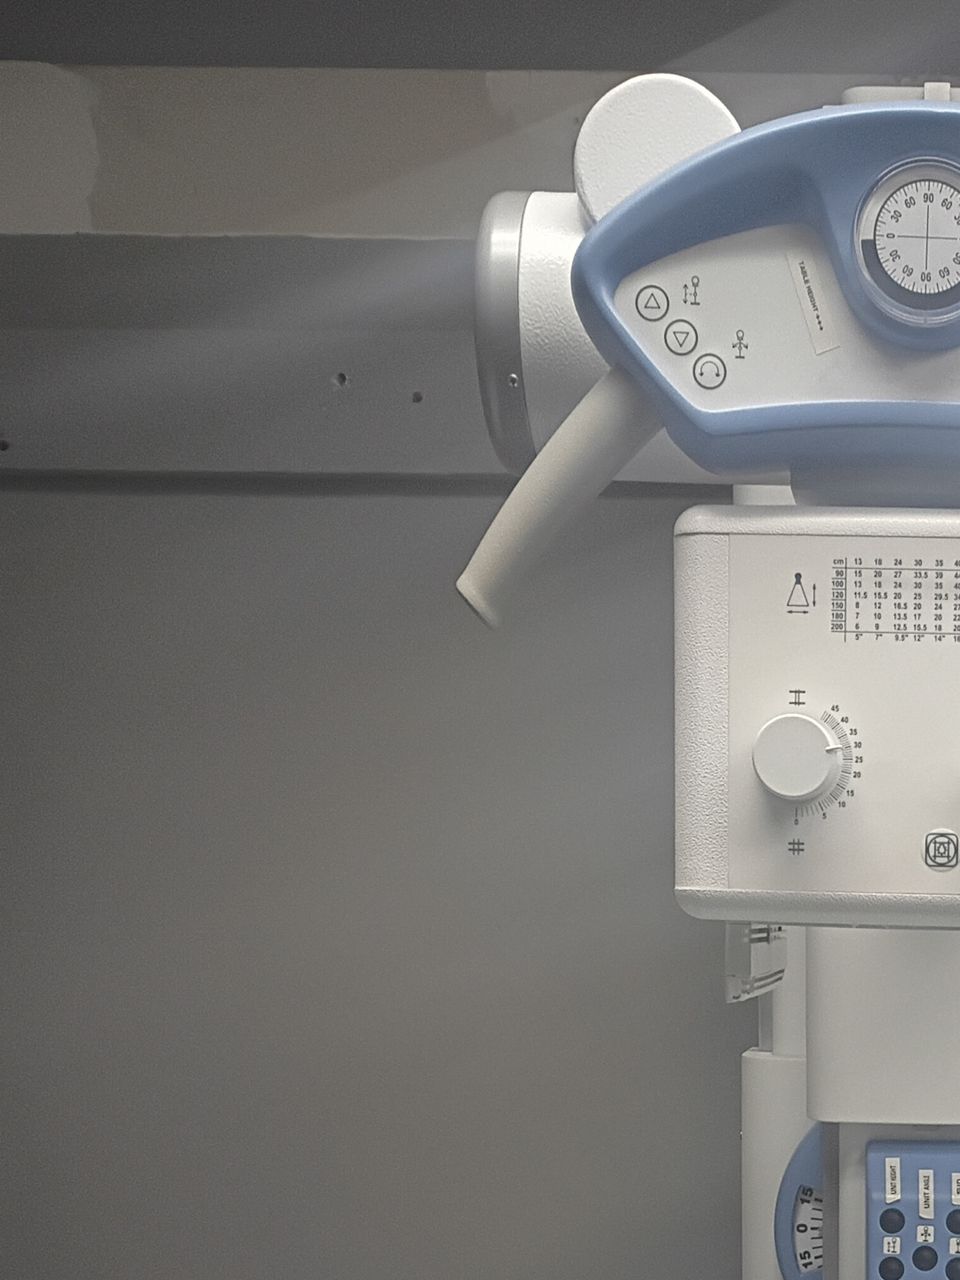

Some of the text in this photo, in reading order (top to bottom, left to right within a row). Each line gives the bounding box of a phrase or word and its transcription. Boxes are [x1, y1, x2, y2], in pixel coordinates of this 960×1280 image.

[904, 196, 916, 209] 60
[923, 193, 934, 203] 90
[940, 198, 953, 210] 60
[891, 210, 902, 223] 30
[889, 249, 901, 262] 30
[902, 265, 914, 277] 60
[938, 267, 950, 279] 60
[920, 272, 932, 282] 90
[854, 558, 862, 566] 13
[874, 558, 883, 566] 18
[914, 559, 923, 567] 30
[854, 570, 862, 578] 15
[874, 570, 883, 578] 20
[914, 571, 929, 579] 33.5
[935, 571, 943, 579] 39
[874, 581, 882, 589] 18
[893, 581, 902, 589] 24
[913, 581, 922, 589] 30
[935, 582, 943, 590] 35
[832, 591, 844, 599] 120
[893, 592, 902, 600] 20
[934, 593, 949, 601] 29.5
[934, 603, 943, 611] 24
[831, 612, 844, 620] 180
[874, 612, 882, 620] 10
[914, 613, 921, 621] 17
[934, 613, 943, 621] 20
[893, 623, 908, 631] 12.5
[854, 741, 862, 749] 30
[800, 1187, 814, 1205] 15
[797, 1224, 808, 1233] 0
[800, 1251, 813, 1269] 15
